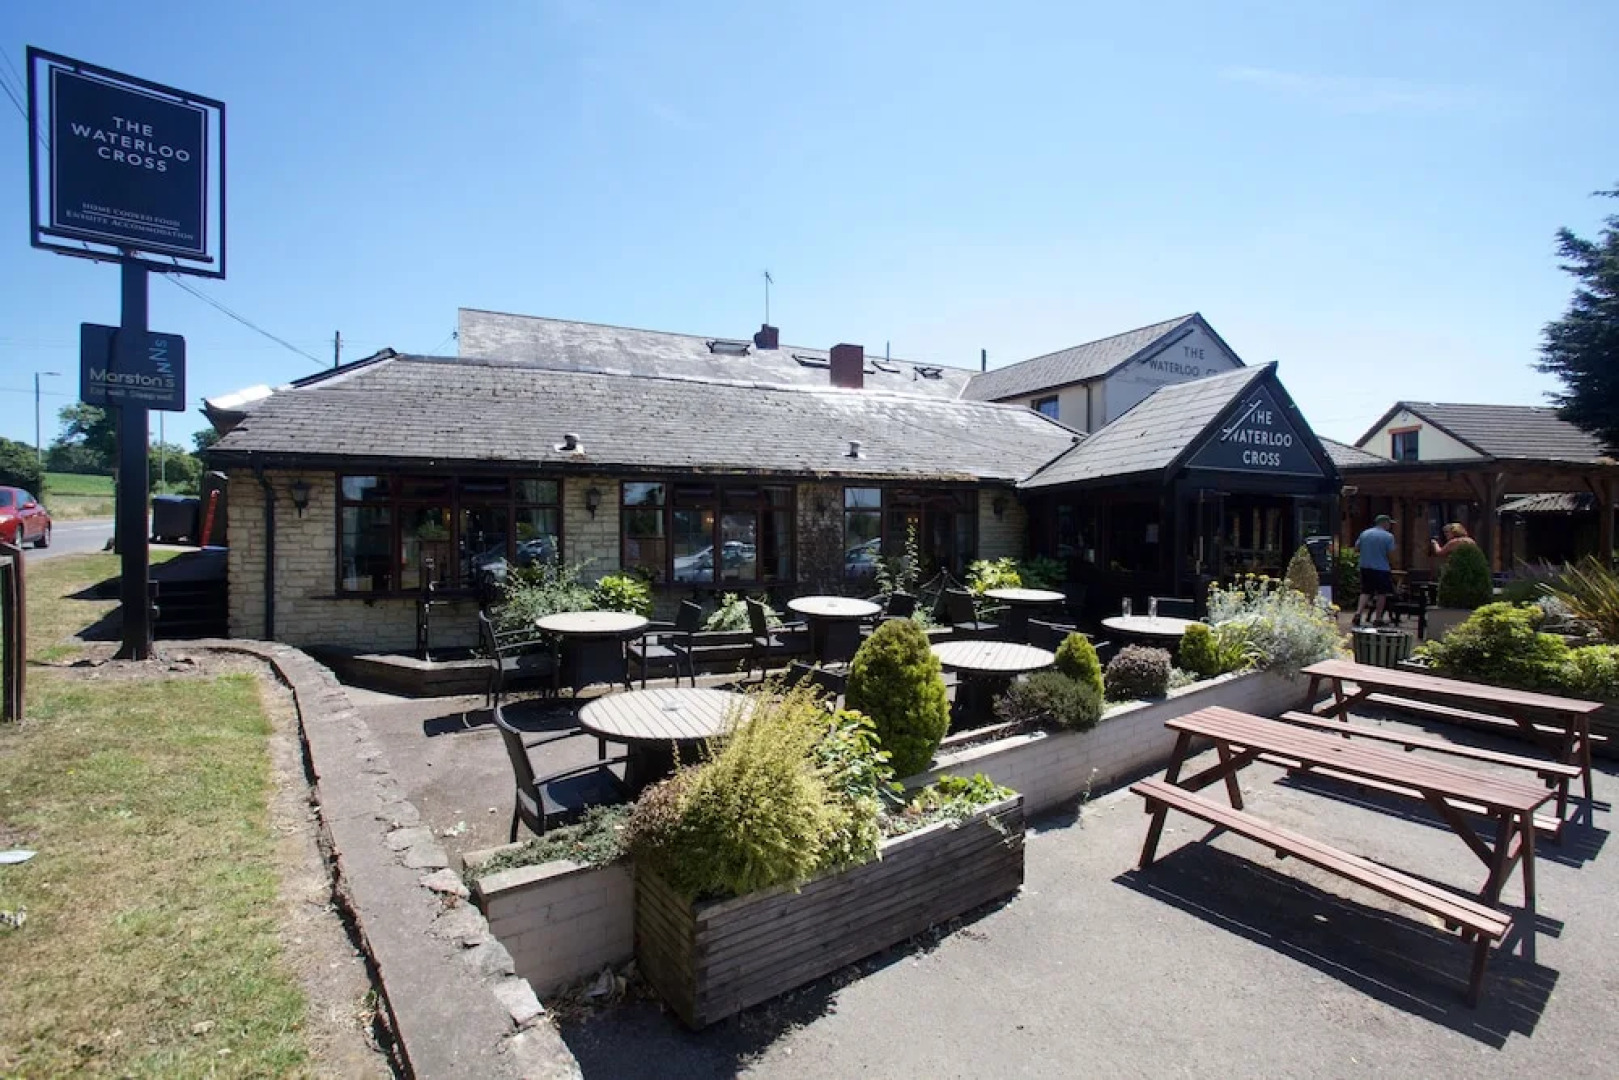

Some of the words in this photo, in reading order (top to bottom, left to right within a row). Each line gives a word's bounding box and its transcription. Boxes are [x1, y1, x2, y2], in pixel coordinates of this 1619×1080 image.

[112, 116, 153, 137] THE
[71, 122, 190, 162] WATERLOO
[98, 146, 167, 172] CROSS
[1184, 346, 1205, 360] THE
[1149, 360, 1200, 377] WATERLOO
[1249, 409, 1272, 425] THE
[1228, 428, 1293, 447] WATERLOO
[1242, 450, 1280, 467] CROSS
